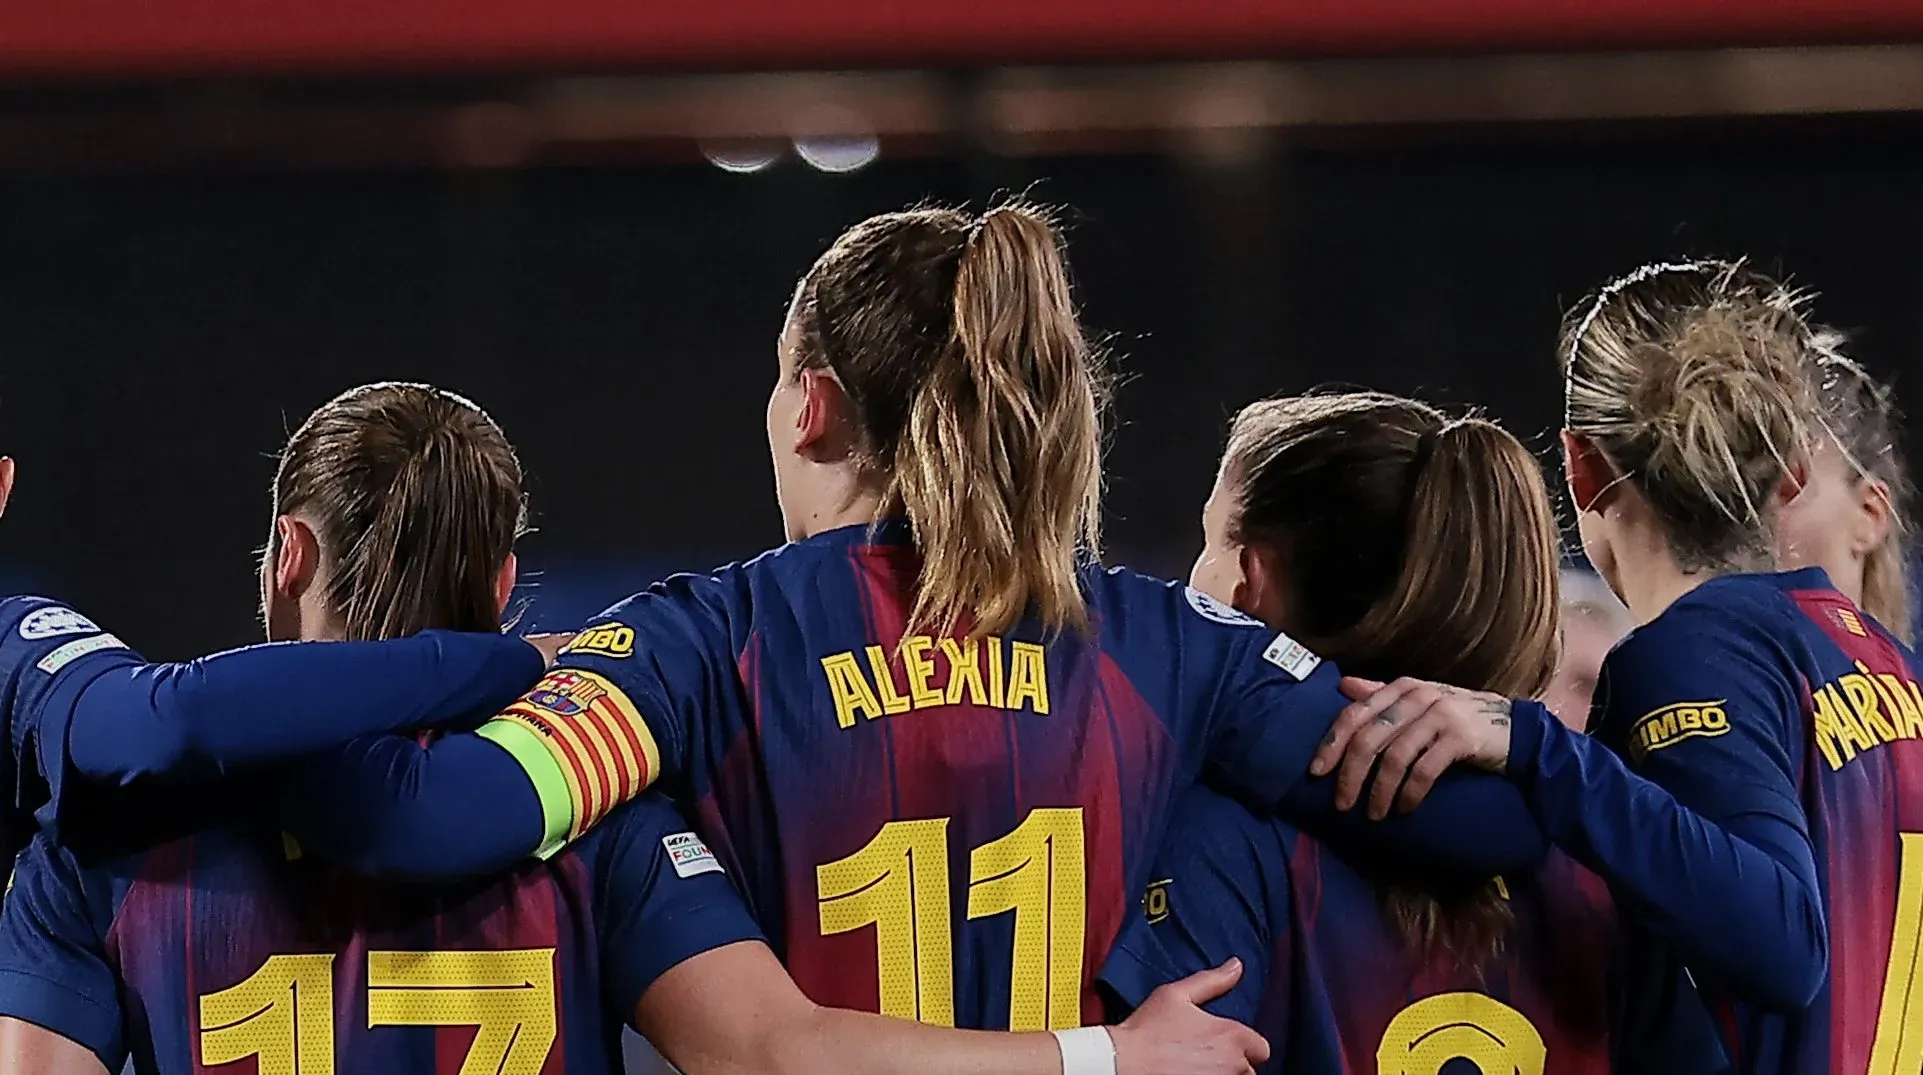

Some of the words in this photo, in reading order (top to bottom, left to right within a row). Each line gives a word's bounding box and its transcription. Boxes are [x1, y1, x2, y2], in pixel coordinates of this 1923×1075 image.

[570, 627, 635, 653] MBO
[820, 636, 1049, 729] ALEXIA
[1638, 706, 1727, 748] IMBO
[816, 807, 1085, 1034] 11
[199, 947, 558, 1075] 17
